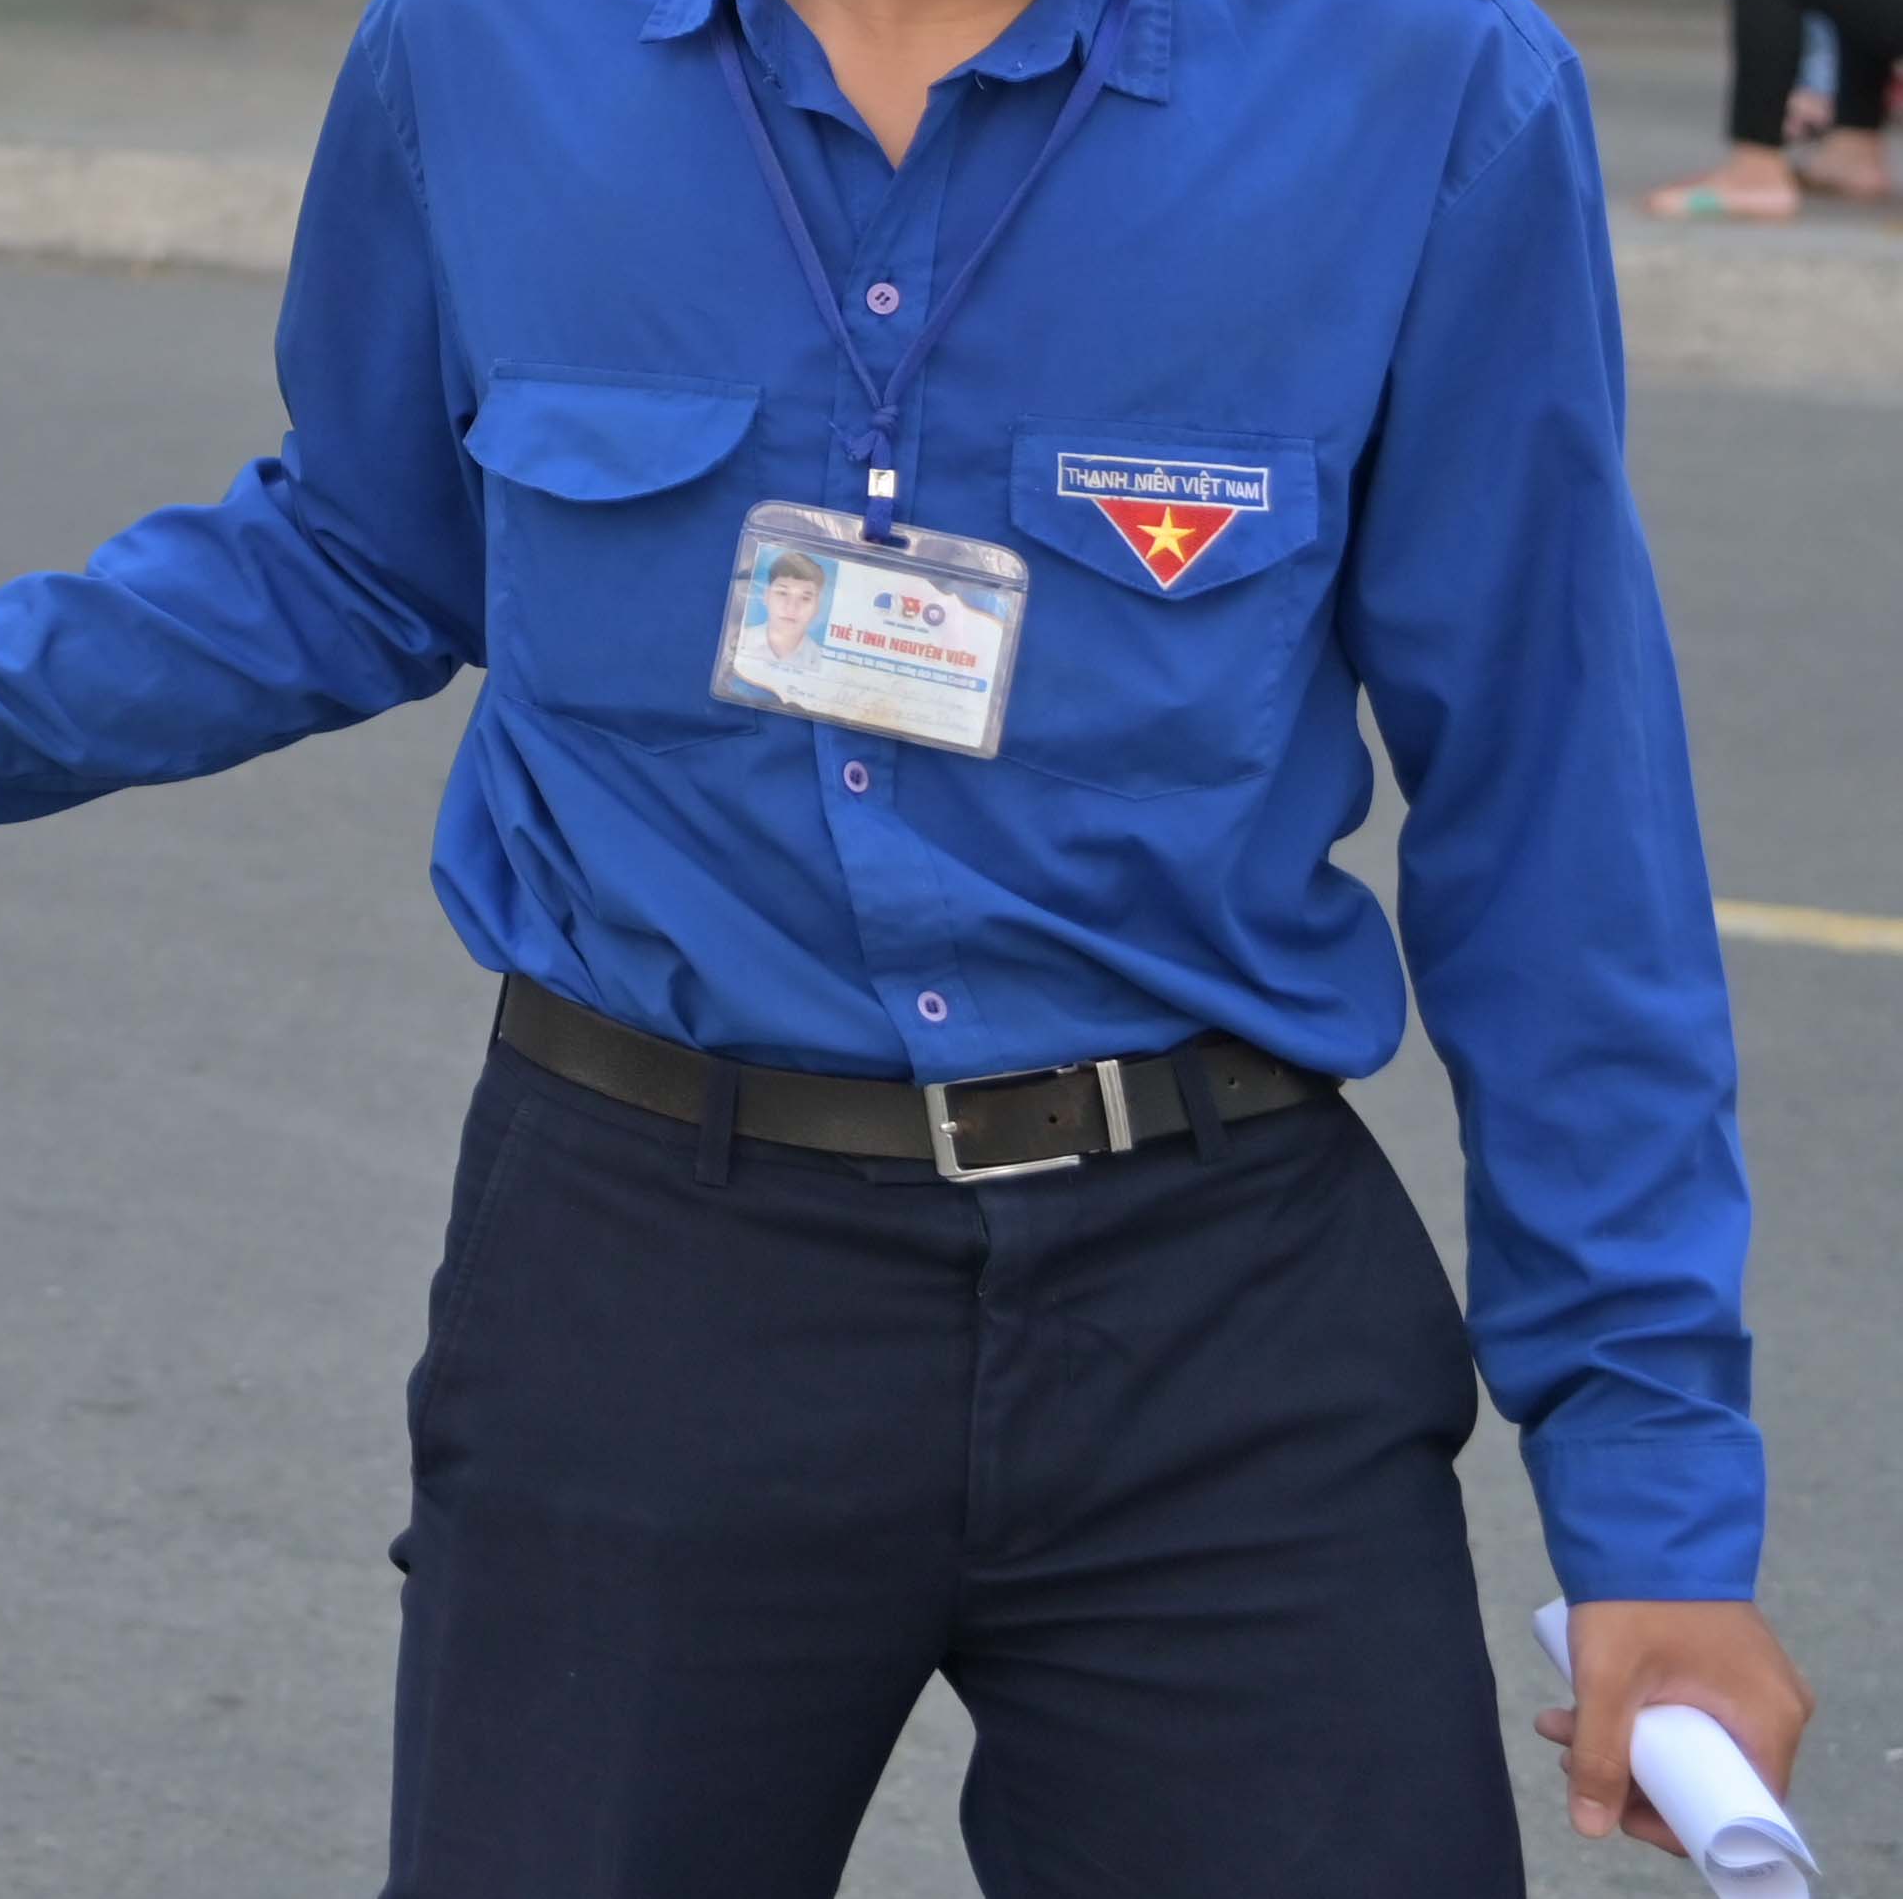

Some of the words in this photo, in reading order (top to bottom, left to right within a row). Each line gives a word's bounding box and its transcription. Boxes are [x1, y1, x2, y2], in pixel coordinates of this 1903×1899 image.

[1066, 466, 1128, 491] THANH
[1133, 466, 1176, 493] NIÊN
[1180, 470, 1226, 501] VIỆT
[1225, 480, 1260, 500] NAM
[829, 623, 853, 641] THẺ
[889, 637, 943, 663] NGUYỆN
[945, 649, 978, 669] VIÊN
